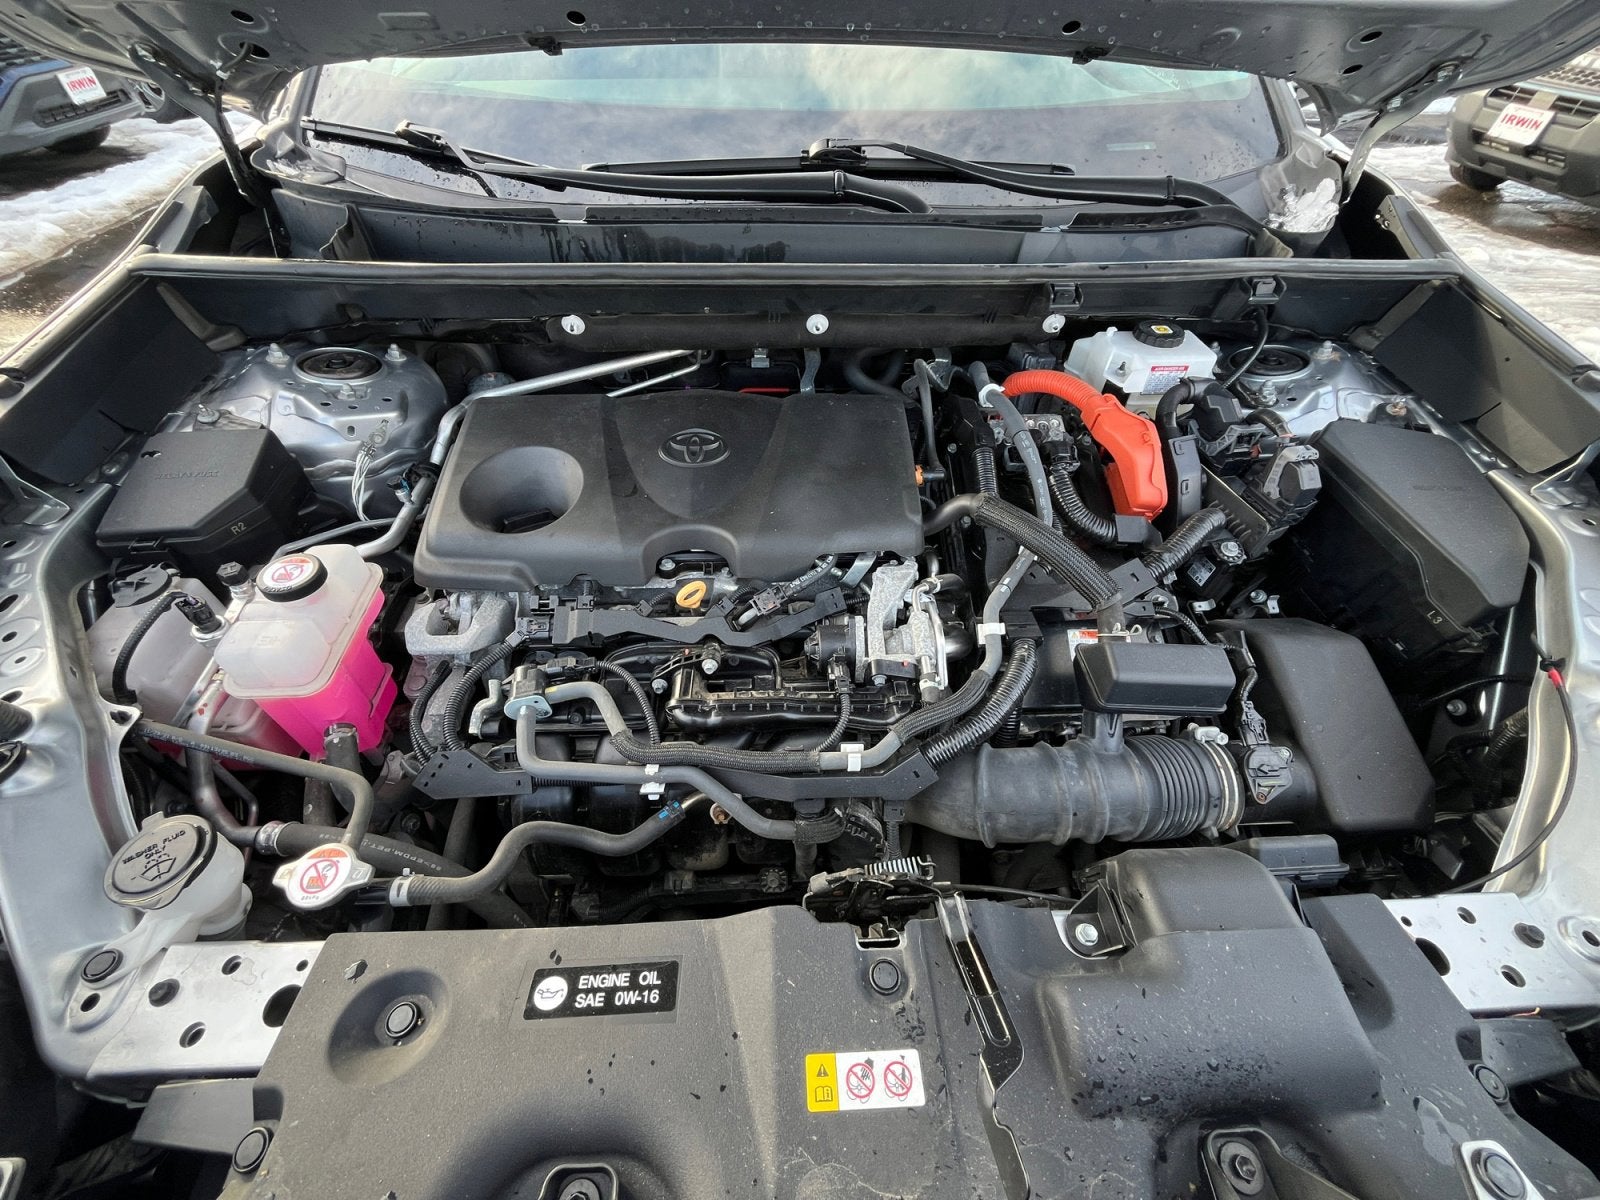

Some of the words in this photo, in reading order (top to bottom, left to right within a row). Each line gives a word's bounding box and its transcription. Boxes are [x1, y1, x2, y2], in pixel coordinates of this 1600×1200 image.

[66, 75, 97, 92] IRWIN
[1500, 113, 1544, 130] IRWIN
[230, 522, 247, 535] R2
[1427, 610, 1443, 624] L3
[162, 829, 186, 844] FLUID
[578, 972, 631, 989] ENGINE
[638, 971, 662, 985] OIL
[574, 992, 605, 1008] SAE
[615, 989, 660, 1006] 0W-16
